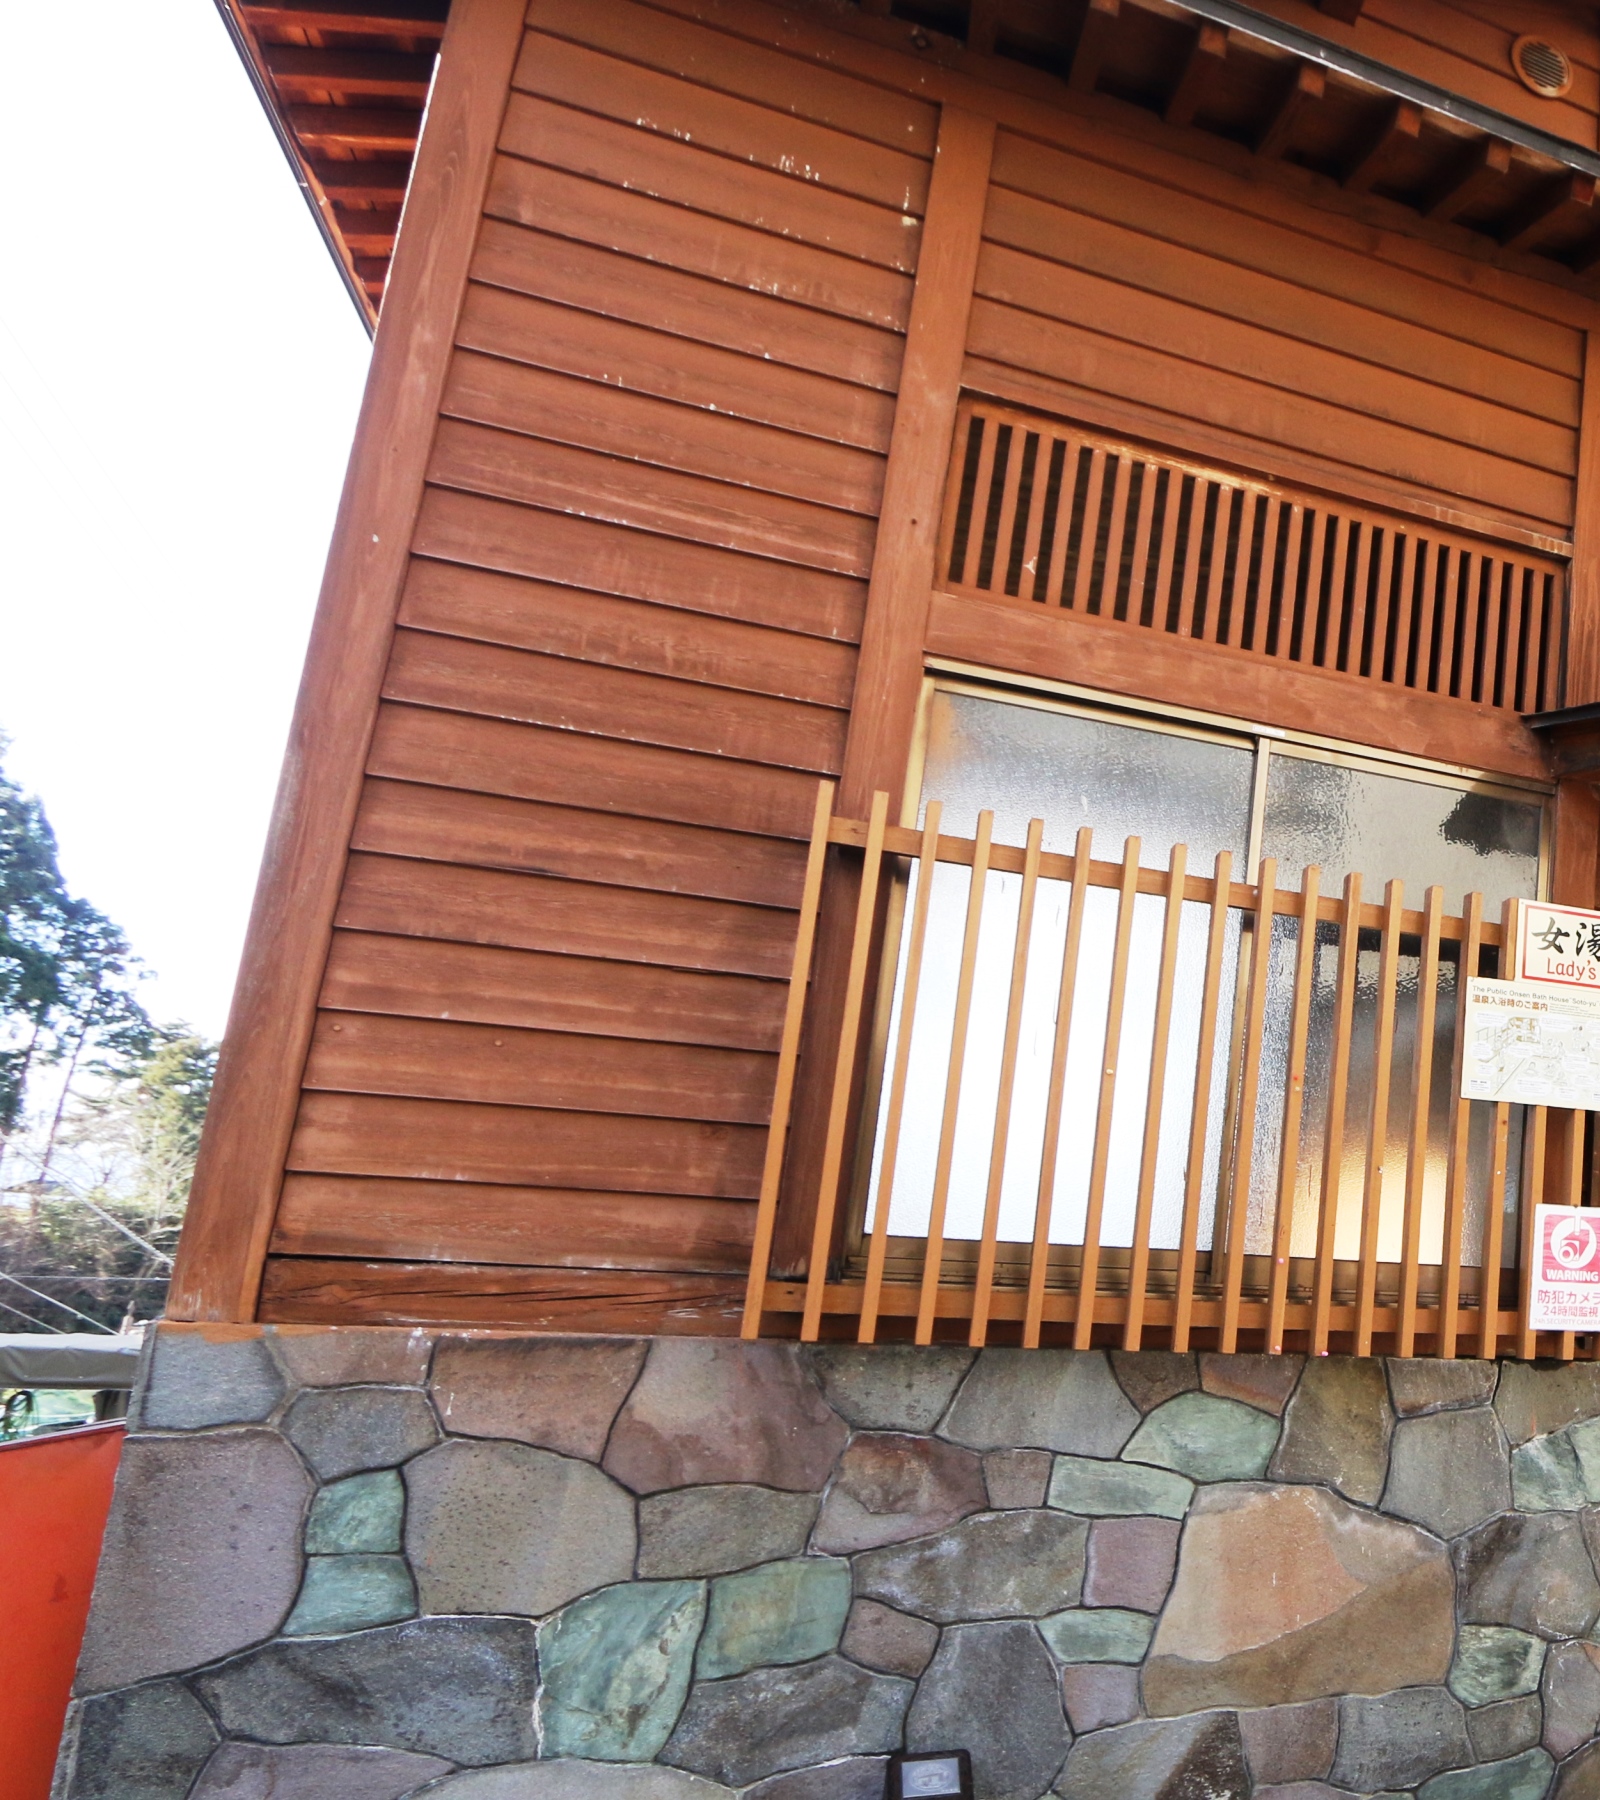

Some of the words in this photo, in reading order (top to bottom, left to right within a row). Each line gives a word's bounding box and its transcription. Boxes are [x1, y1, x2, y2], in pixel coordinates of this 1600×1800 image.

[1546, 957, 1597, 981] Lady's
[1472, 985, 1485, 993] The
[1486, 987, 1507, 996] Public
[1509, 990, 1531, 999] Onsen
[1532, 993, 1547, 1001] Bath
[1549, 995, 1569, 1003] House
[1472, 994, 1548, 1012] 温泉入浴時のご案内
[1545, 1268, 1599, 1282] WARNING
[1543, 1305, 1599, 1318] 24時間監視
